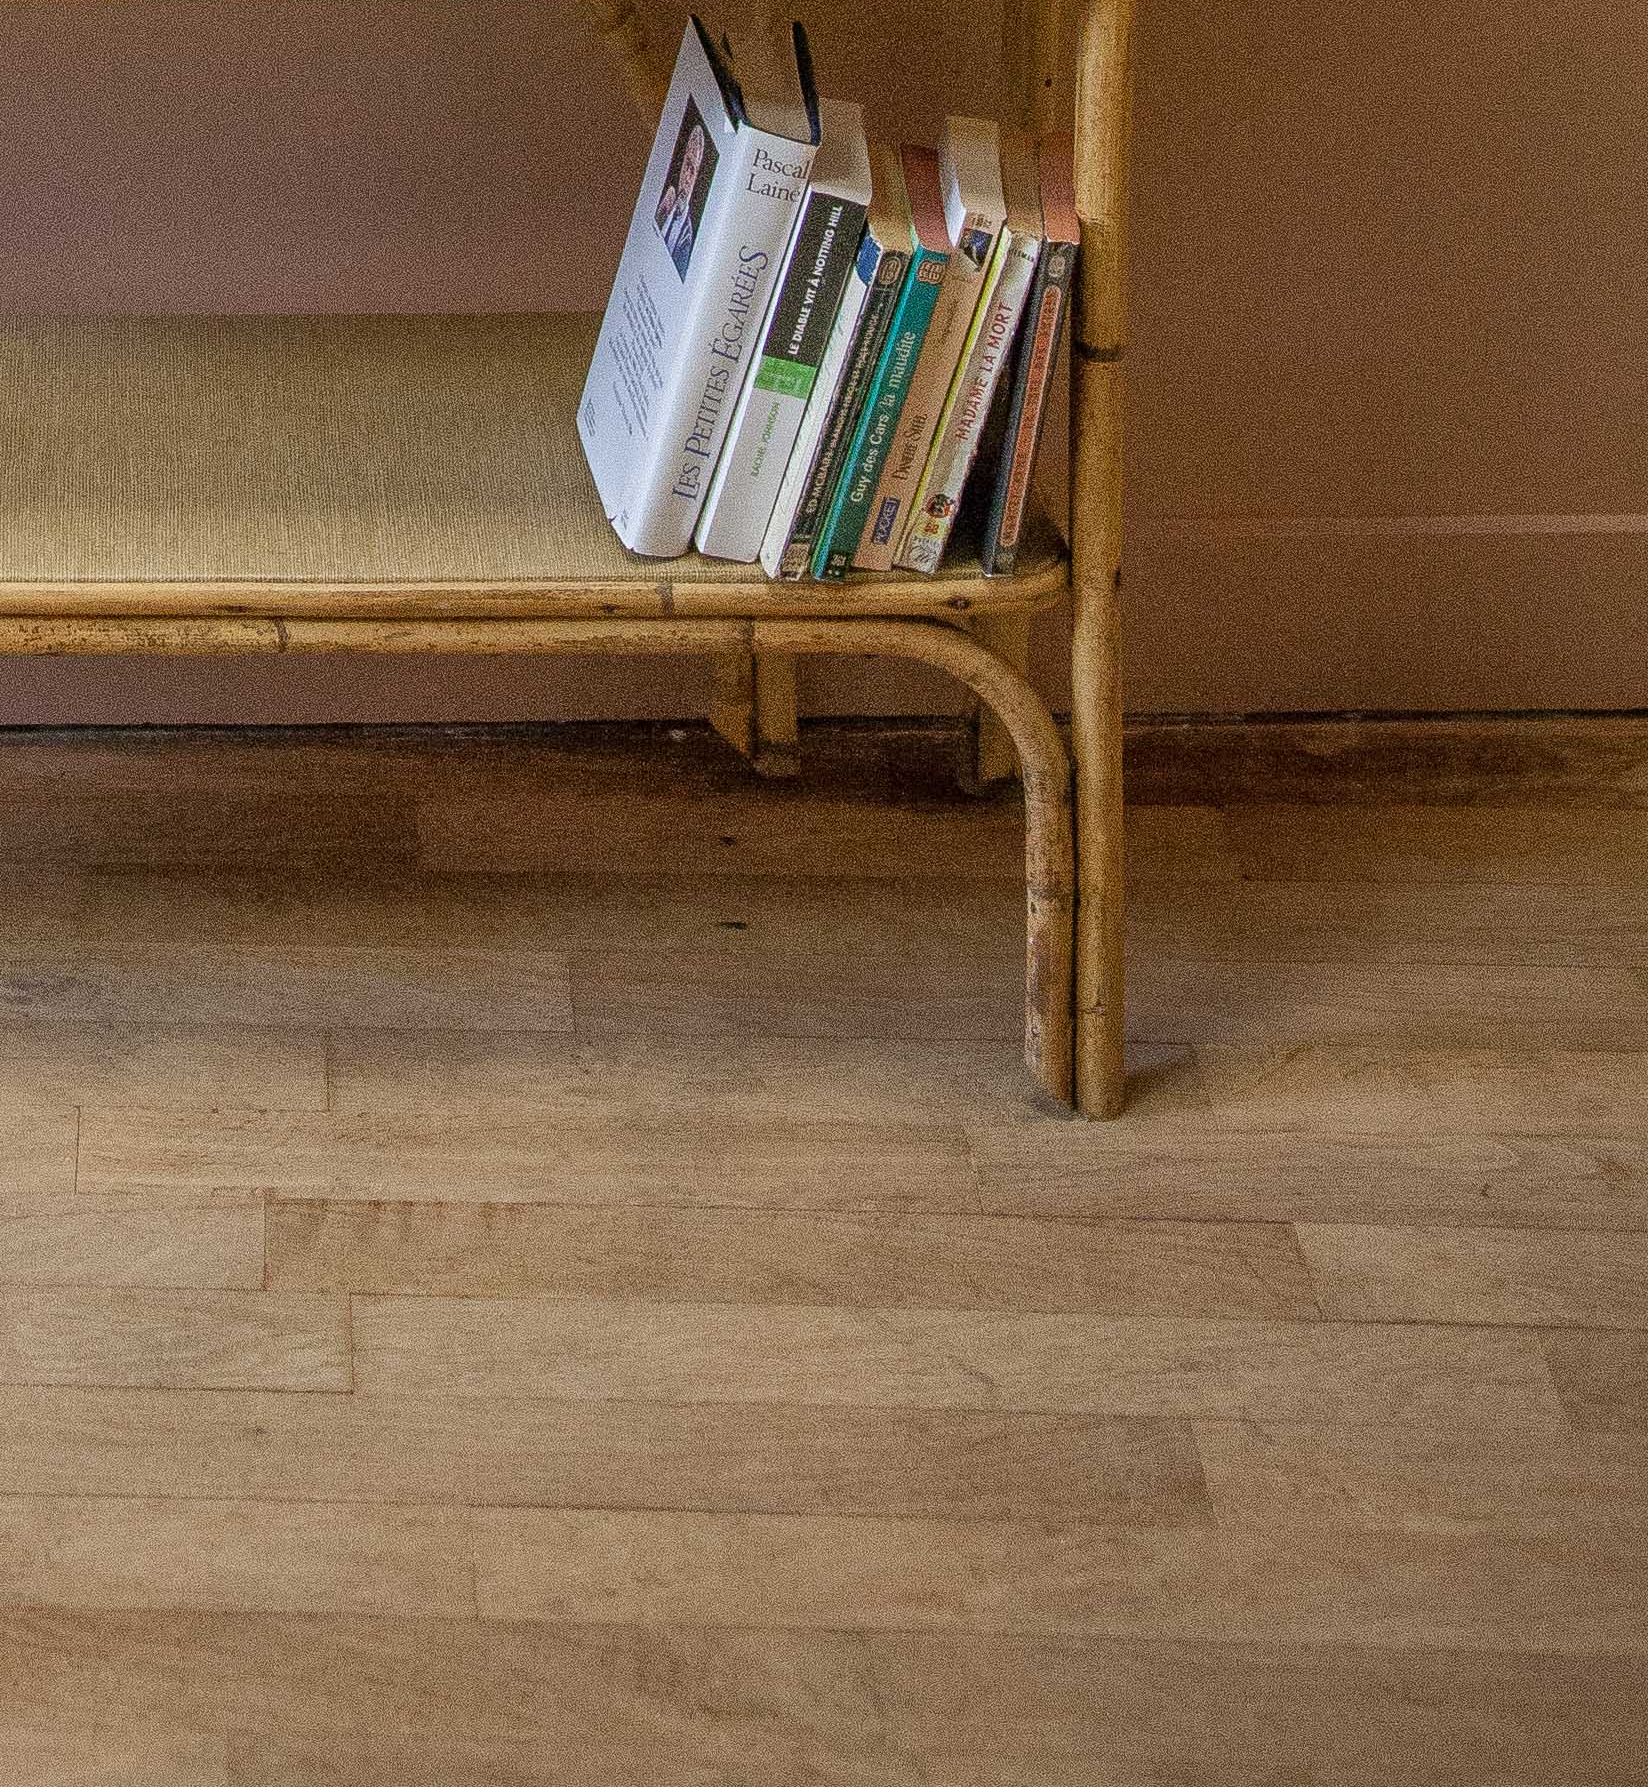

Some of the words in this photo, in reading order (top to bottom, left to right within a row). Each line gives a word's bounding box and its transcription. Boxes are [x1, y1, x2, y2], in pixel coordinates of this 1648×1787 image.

[752, 148, 810, 179] Pascal
[747, 172, 801, 201] Lainé
[826, 203, 843, 228] HILL
[811, 227, 836, 276] NOTTING
[802, 286, 817, 305] VIT
[804, 274, 820, 287] À
[705, 243, 771, 363] ÉGARÉES
[790, 306, 811, 342] DIABLE
[985, 300, 1014, 350] MORT
[787, 343, 799, 355] LE
[886, 329, 916, 388] maudite
[978, 352, 996, 373] LA
[682, 364, 732, 457] PETITES
[759, 400, 781, 443] JOHNSON
[904, 409, 928, 442] STEEL
[955, 376, 987, 441] MADAME
[860, 446, 878, 472] des
[891, 440, 918, 481] DANIELLE
[671, 461, 705, 501] LES
[849, 474, 872, 504] Guy
